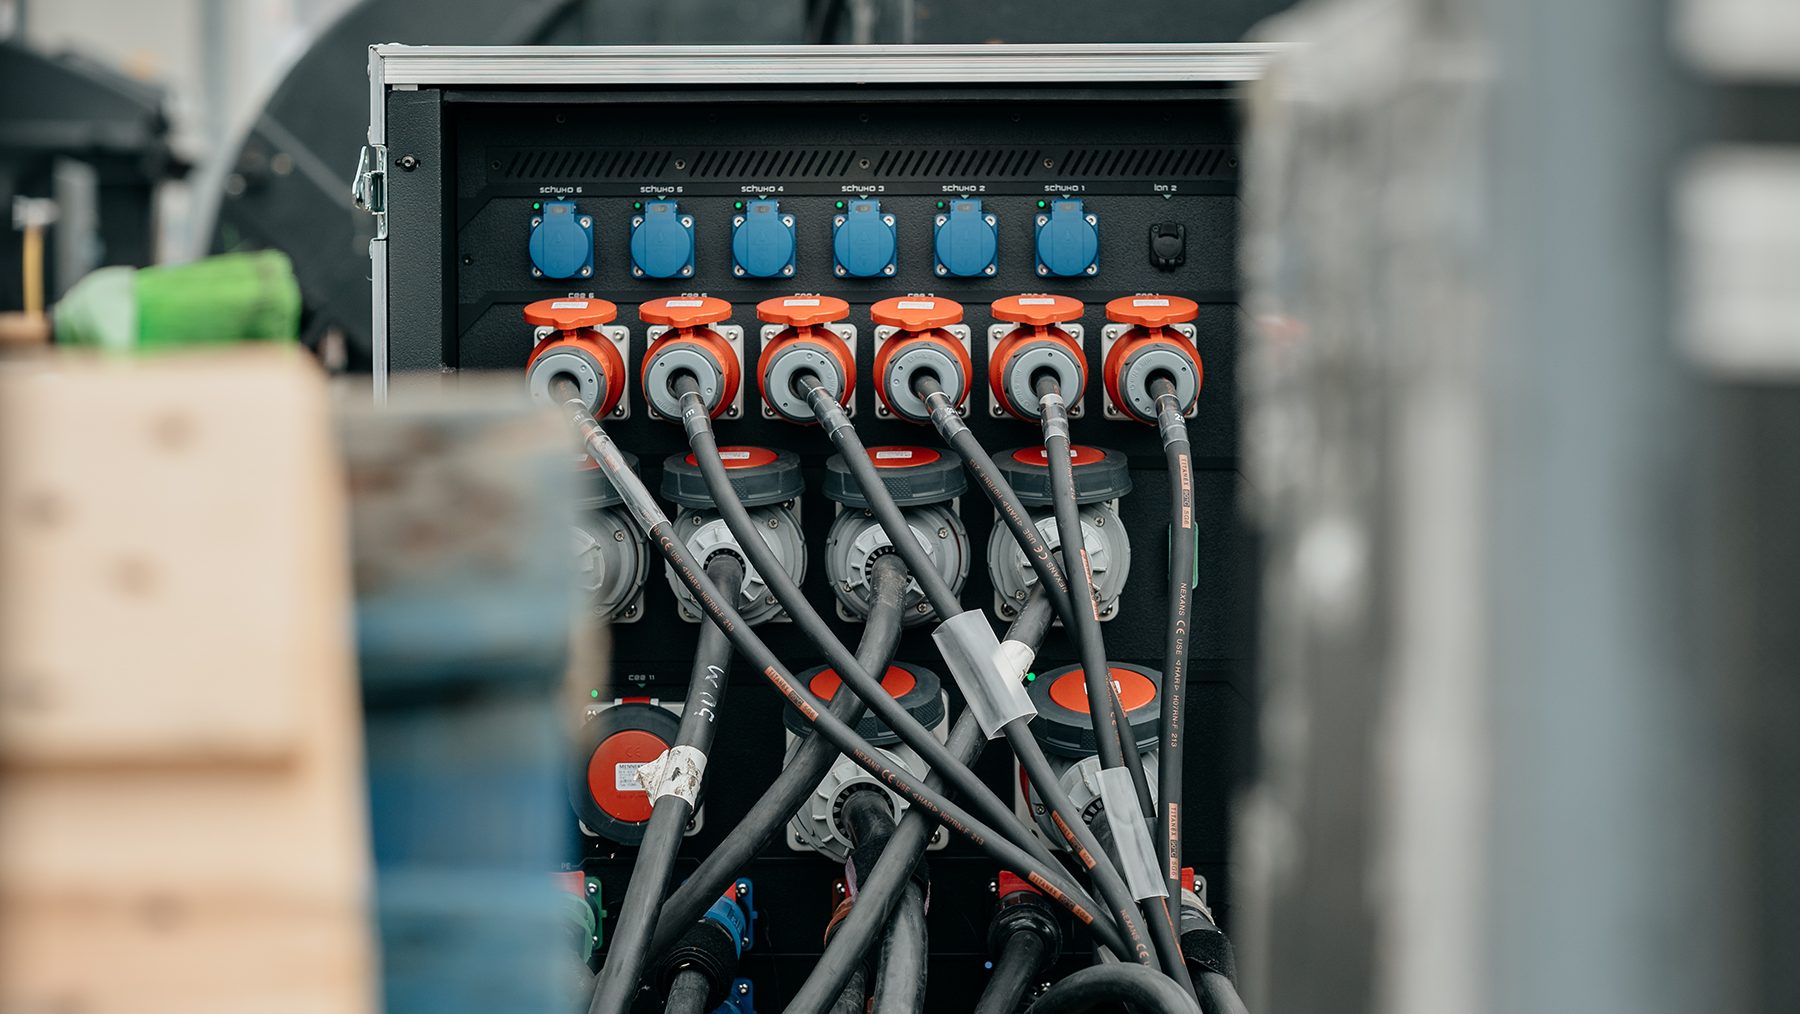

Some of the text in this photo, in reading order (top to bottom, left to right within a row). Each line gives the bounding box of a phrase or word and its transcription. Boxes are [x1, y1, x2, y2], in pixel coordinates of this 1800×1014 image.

[1180, 458, 1189, 486] TITANEX
[669, 549, 683, 565] USE
[1044, 560, 1071, 593] NEXANS
[1177, 582, 1187, 616] NEXANS
[767, 669, 790, 691] TITANEX
[1170, 694, 1180, 728] H07RN-F
[852, 748, 881, 772] NEXANS
[895, 779, 911, 794] USE
[1030, 873, 1057, 897] TITANEX
[1119, 908, 1140, 941] NEXANS
